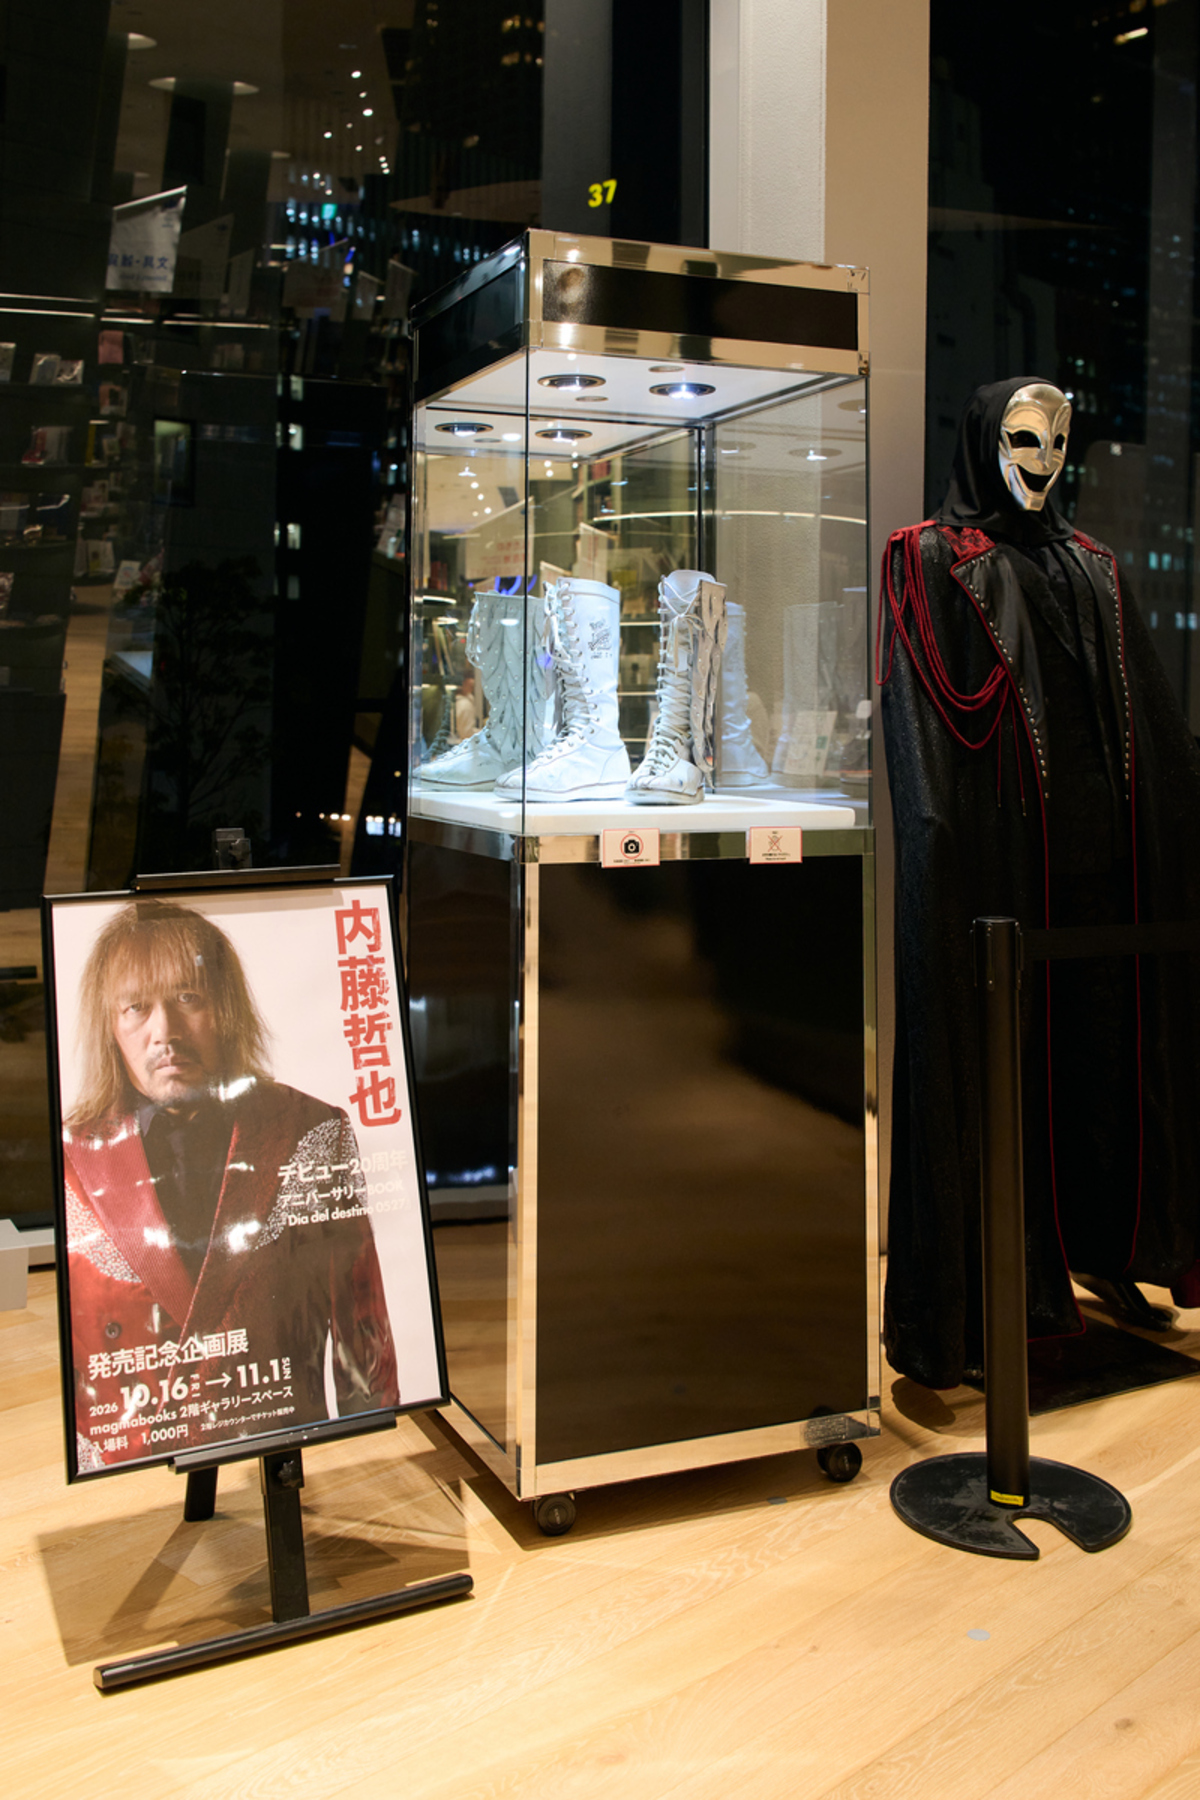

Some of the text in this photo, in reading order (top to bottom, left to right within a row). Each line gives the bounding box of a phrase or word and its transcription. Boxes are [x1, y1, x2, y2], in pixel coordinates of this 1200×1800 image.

[588, 179, 617, 208] 37
[335, 899, 402, 1128] 内藤哲也
[278, 1149, 408, 1186] デビュー20周年
[280, 1180, 404, 1209] アニバーサリーBOOK
[310, 1207, 330, 1223] del
[331, 1203, 374, 1220] destino
[88, 1328, 249, 1381] 発売記念企画展
[89, 1357, 292, 1417] 2026 10.16 FRI 11.1 SUN
[90, 1385, 294, 1436] magmabooks 2階ギャラリースペース
[93, 1435, 129, 1453] 入場料
[141, 1424, 189, 1446] 1,000円
